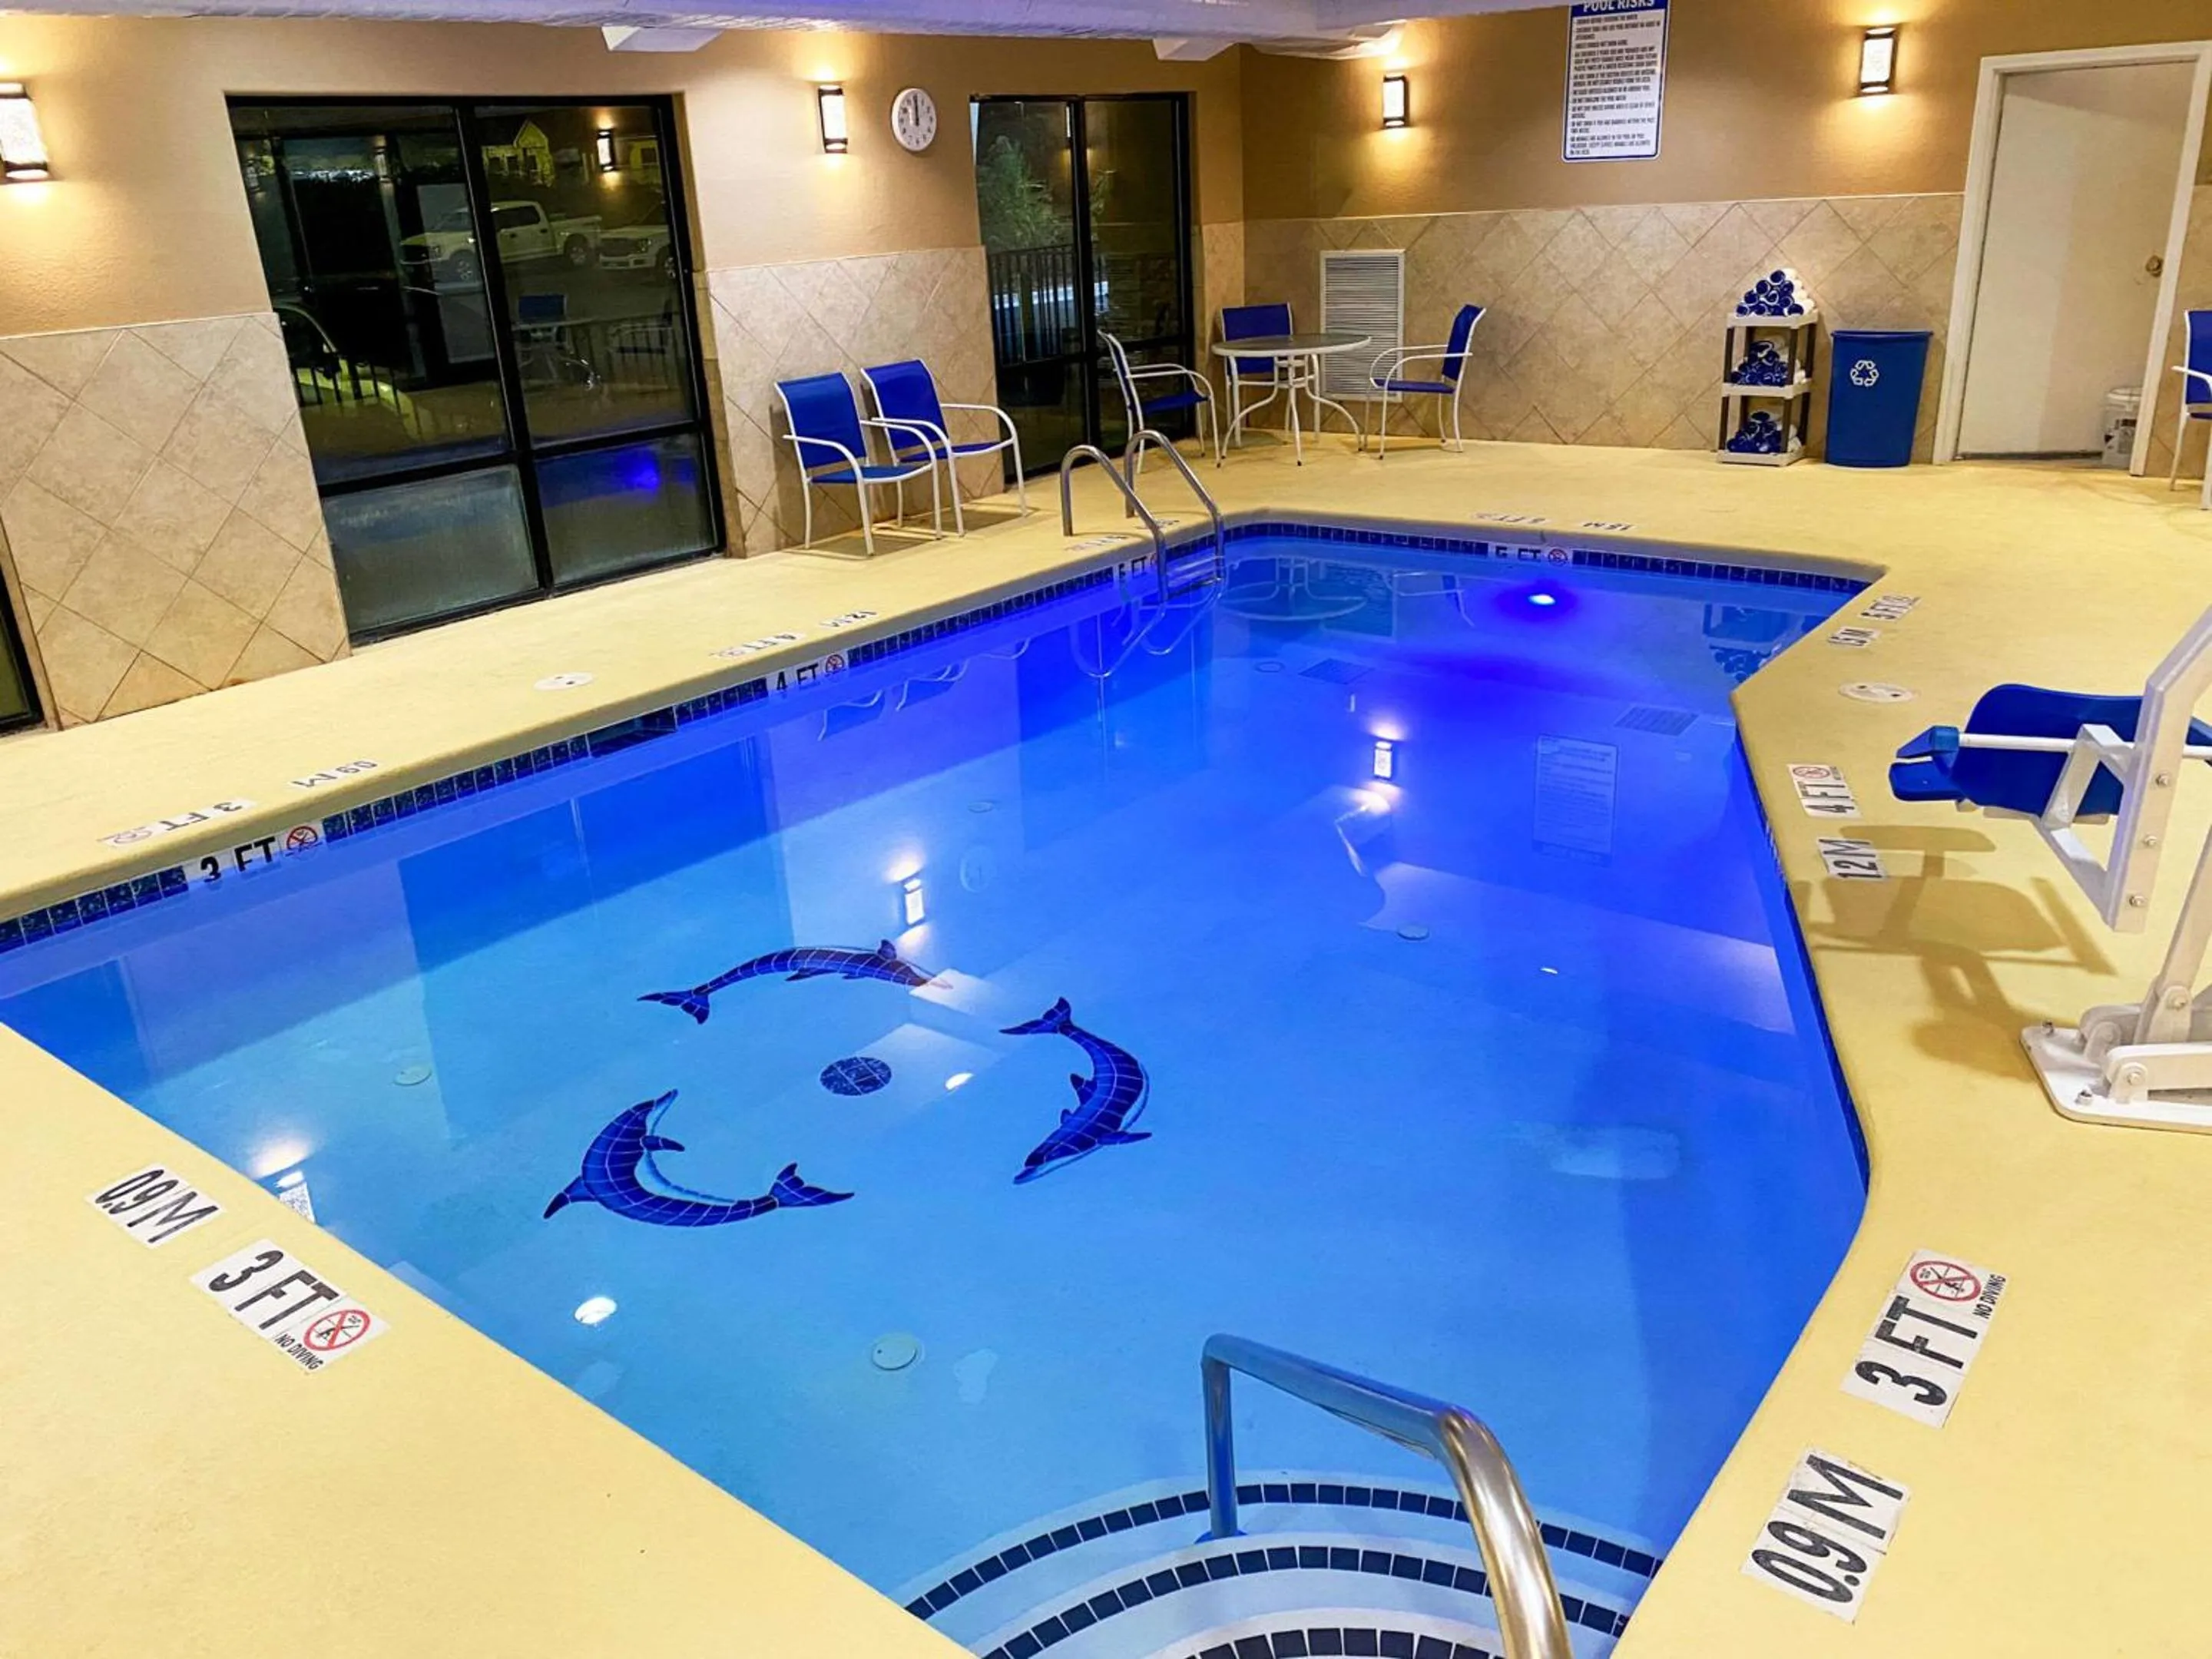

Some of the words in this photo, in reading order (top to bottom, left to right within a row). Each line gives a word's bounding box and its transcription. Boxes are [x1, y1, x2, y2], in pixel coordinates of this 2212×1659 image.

[1583, 0, 1615, 12] POOL
[796, 664, 820, 685] FT
[1796, 781, 1850, 800] FT
[213, 802, 243, 813] 3
[1804, 804, 1856, 813] 4
[159, 812, 210, 831] FT
[200, 856, 222, 883] 3
[233, 836, 276, 872] FT
[208, 1249, 284, 1293] 3
[234, 1269, 339, 1330] FT
[1979, 1273, 2006, 1305] DIVING
[1972, 1303, 1993, 1319] NO
[1874, 1294, 1979, 1369] FT
[274, 1333, 296, 1348] NO
[286, 1343, 323, 1370] DIVING
[1854, 1359, 1948, 1407] 3
